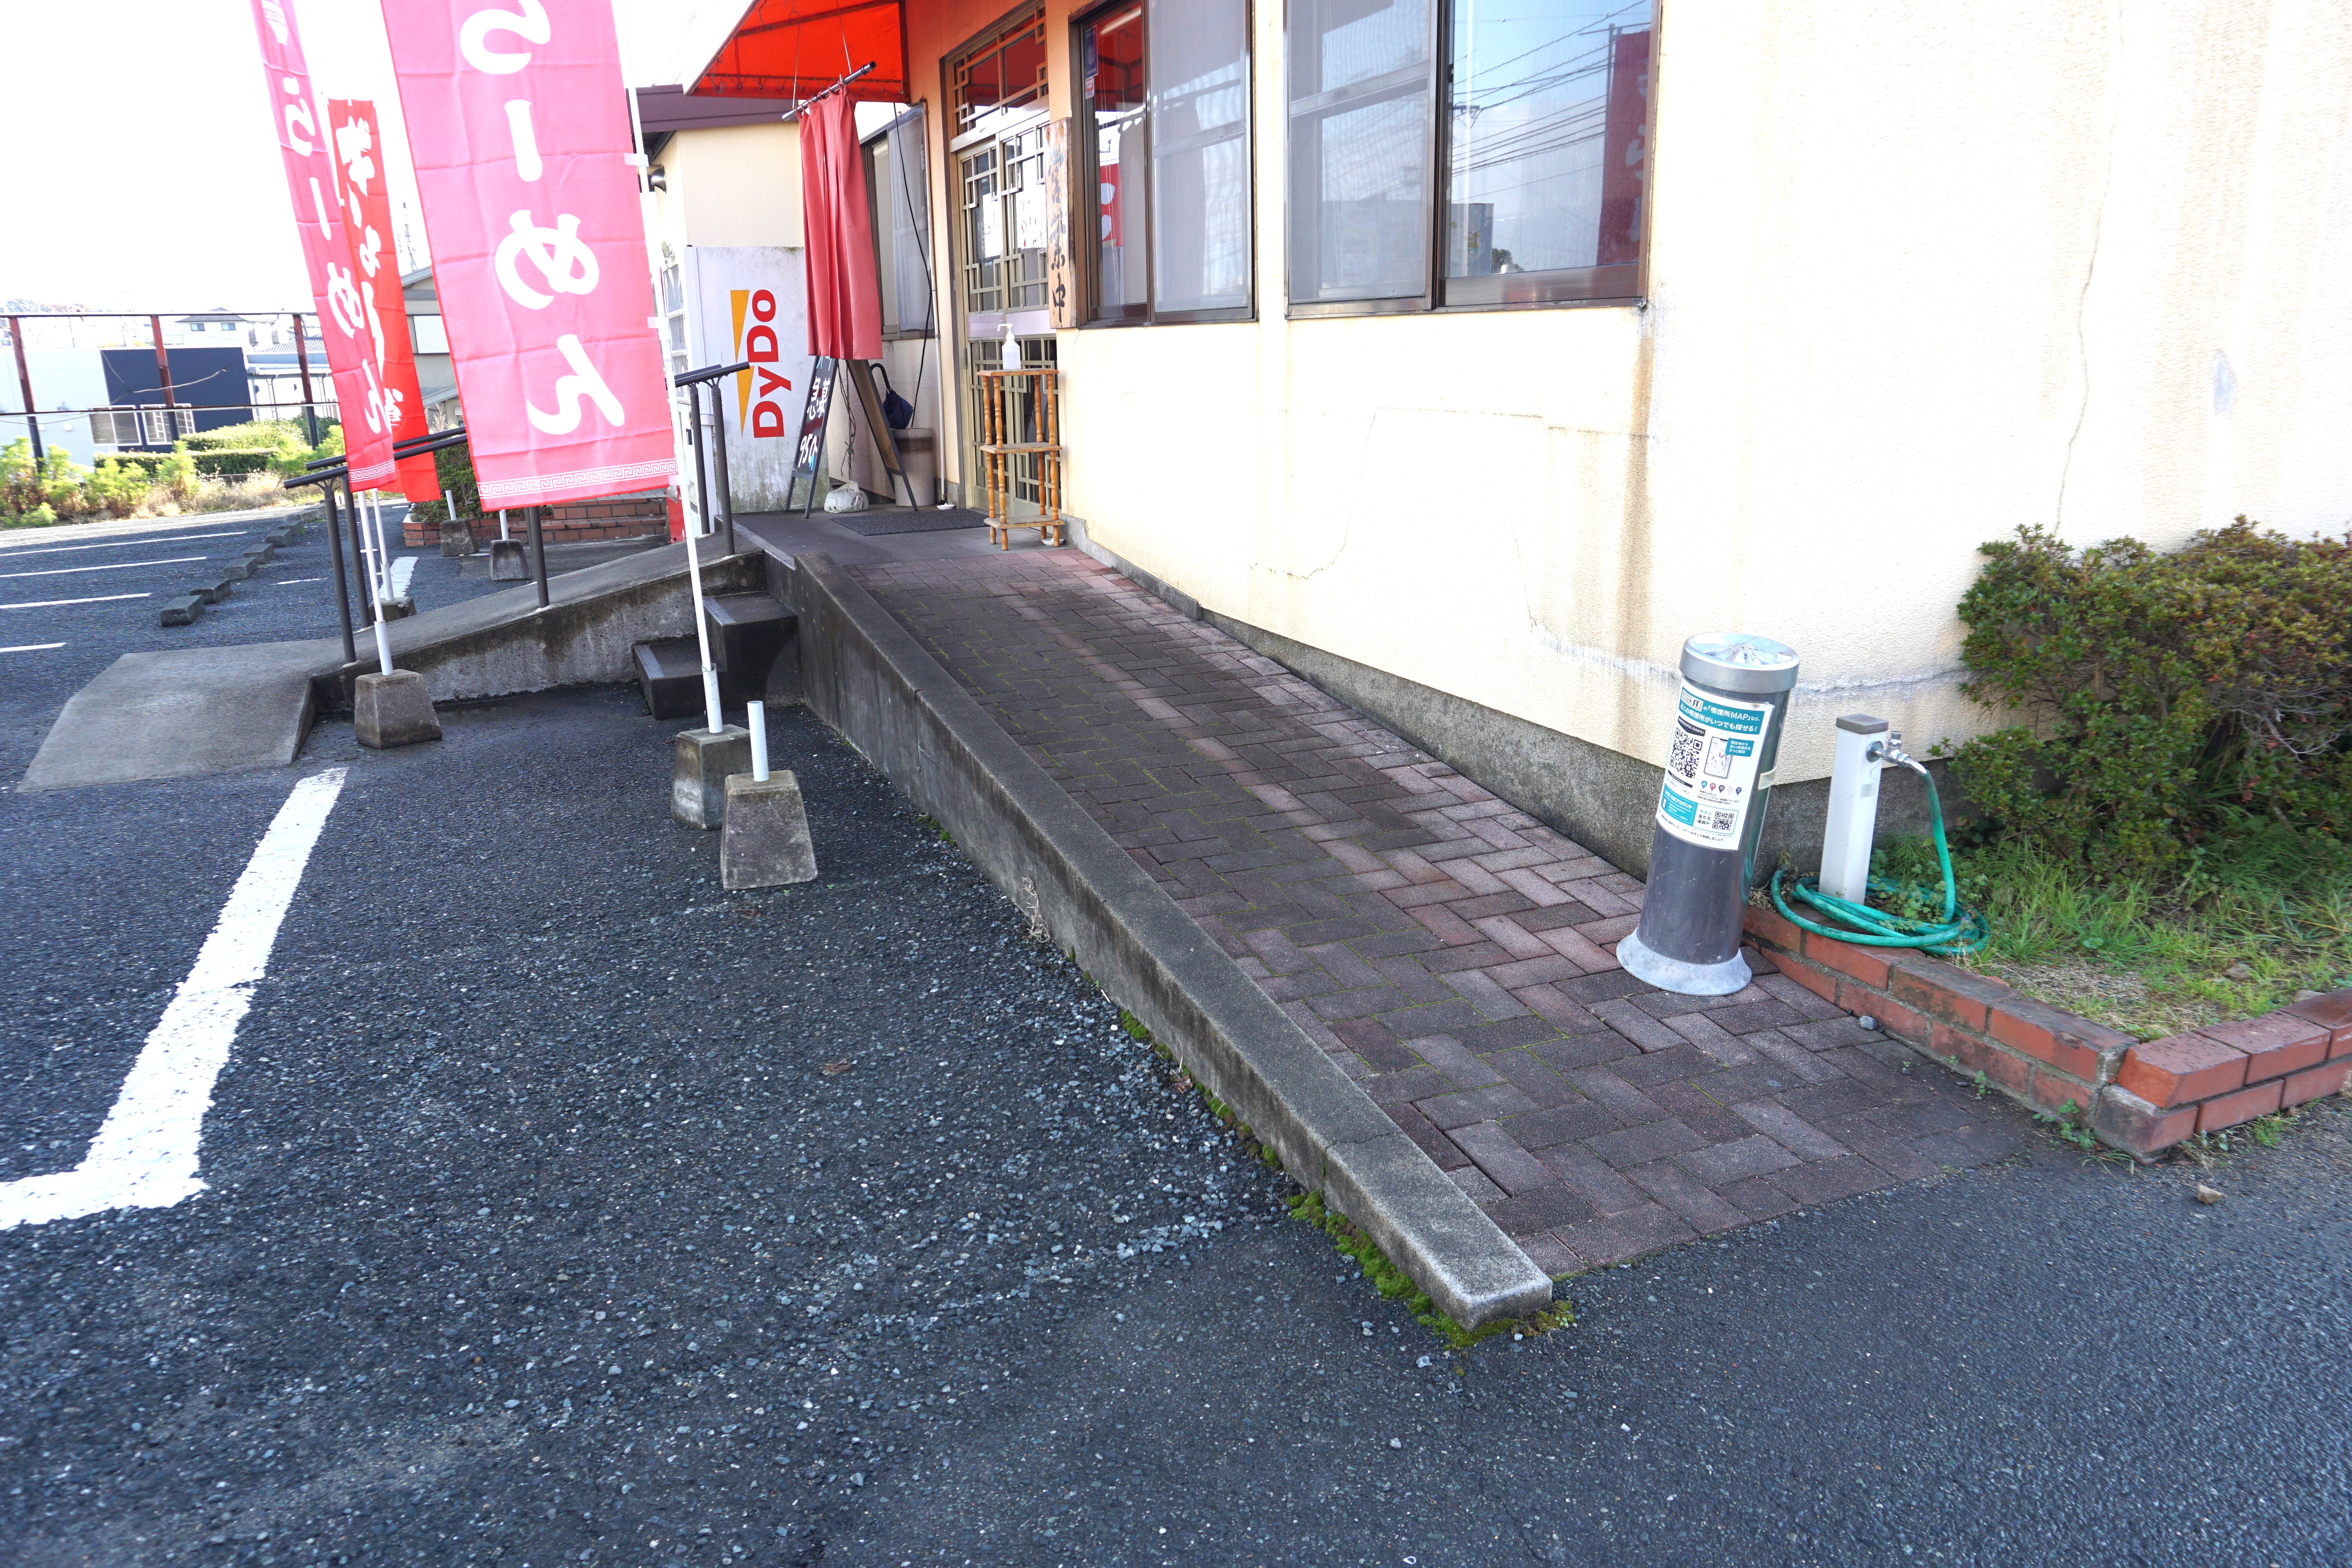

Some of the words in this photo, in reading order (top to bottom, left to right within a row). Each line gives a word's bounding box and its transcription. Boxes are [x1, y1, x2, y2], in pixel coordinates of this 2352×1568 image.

[283, 76, 389, 434] らーめん
[460, 0, 625, 435] らーめん
[1048, 145, 1066, 323] 営業中
[746, 289, 791, 438] DyDo
[807, 376, 830, 420] 急募
[1683, 694, 1691, 703] CLUB
